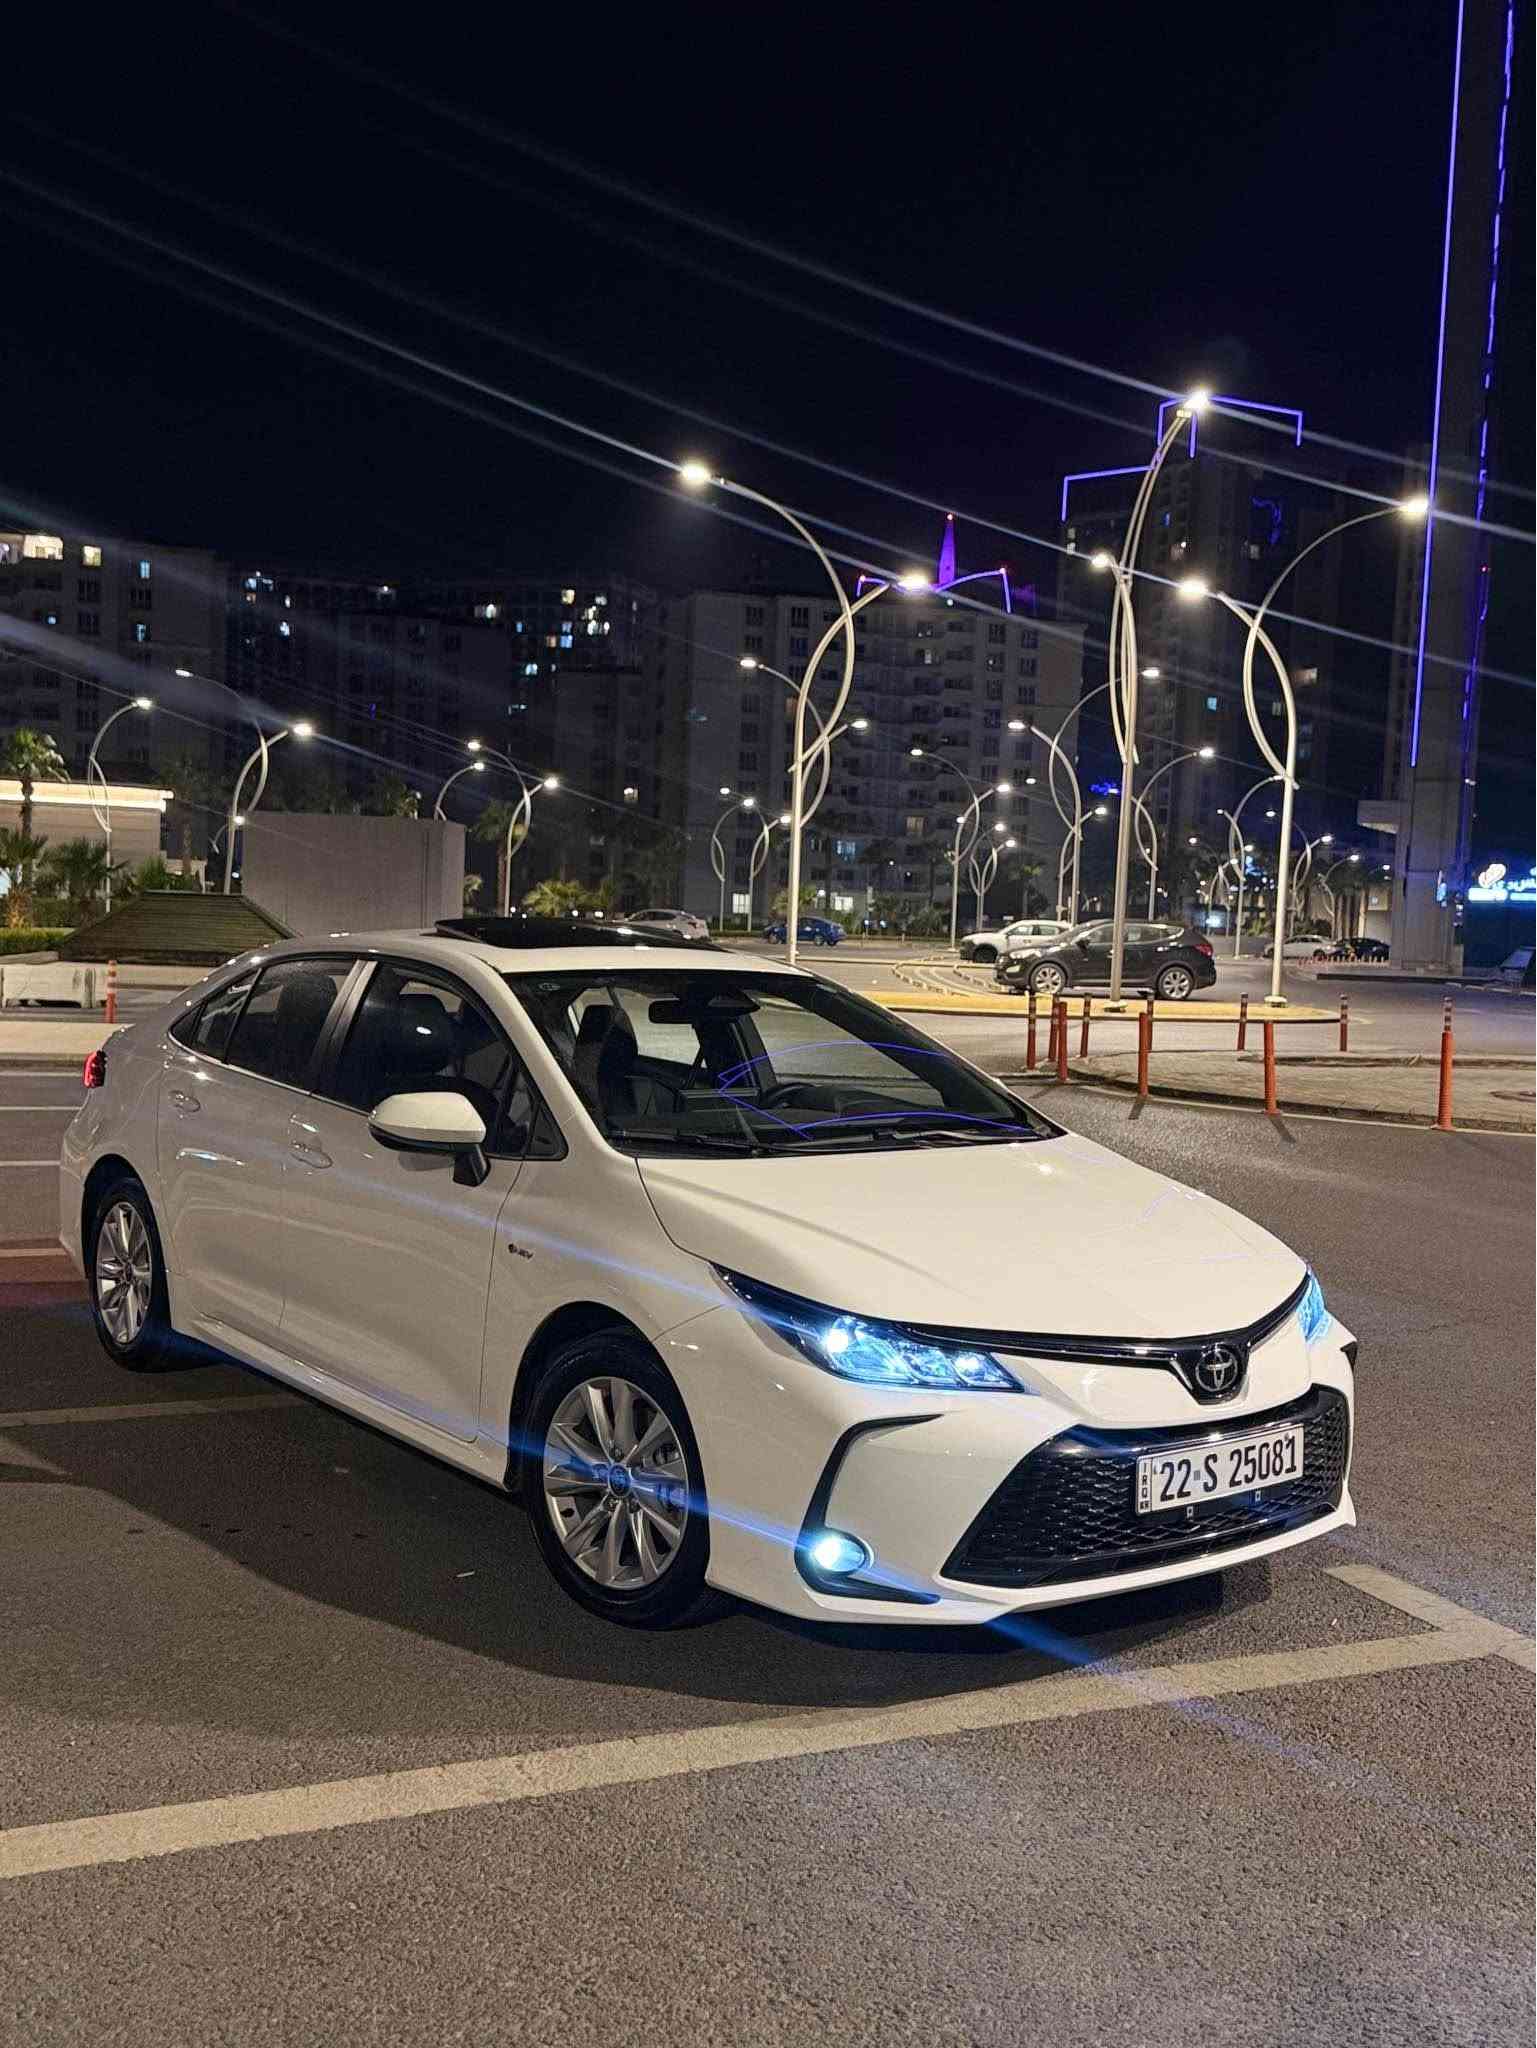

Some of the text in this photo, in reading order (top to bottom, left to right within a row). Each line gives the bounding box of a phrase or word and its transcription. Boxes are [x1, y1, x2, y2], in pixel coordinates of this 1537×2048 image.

[1160, 1435, 1297, 1502] 22 S 25081
